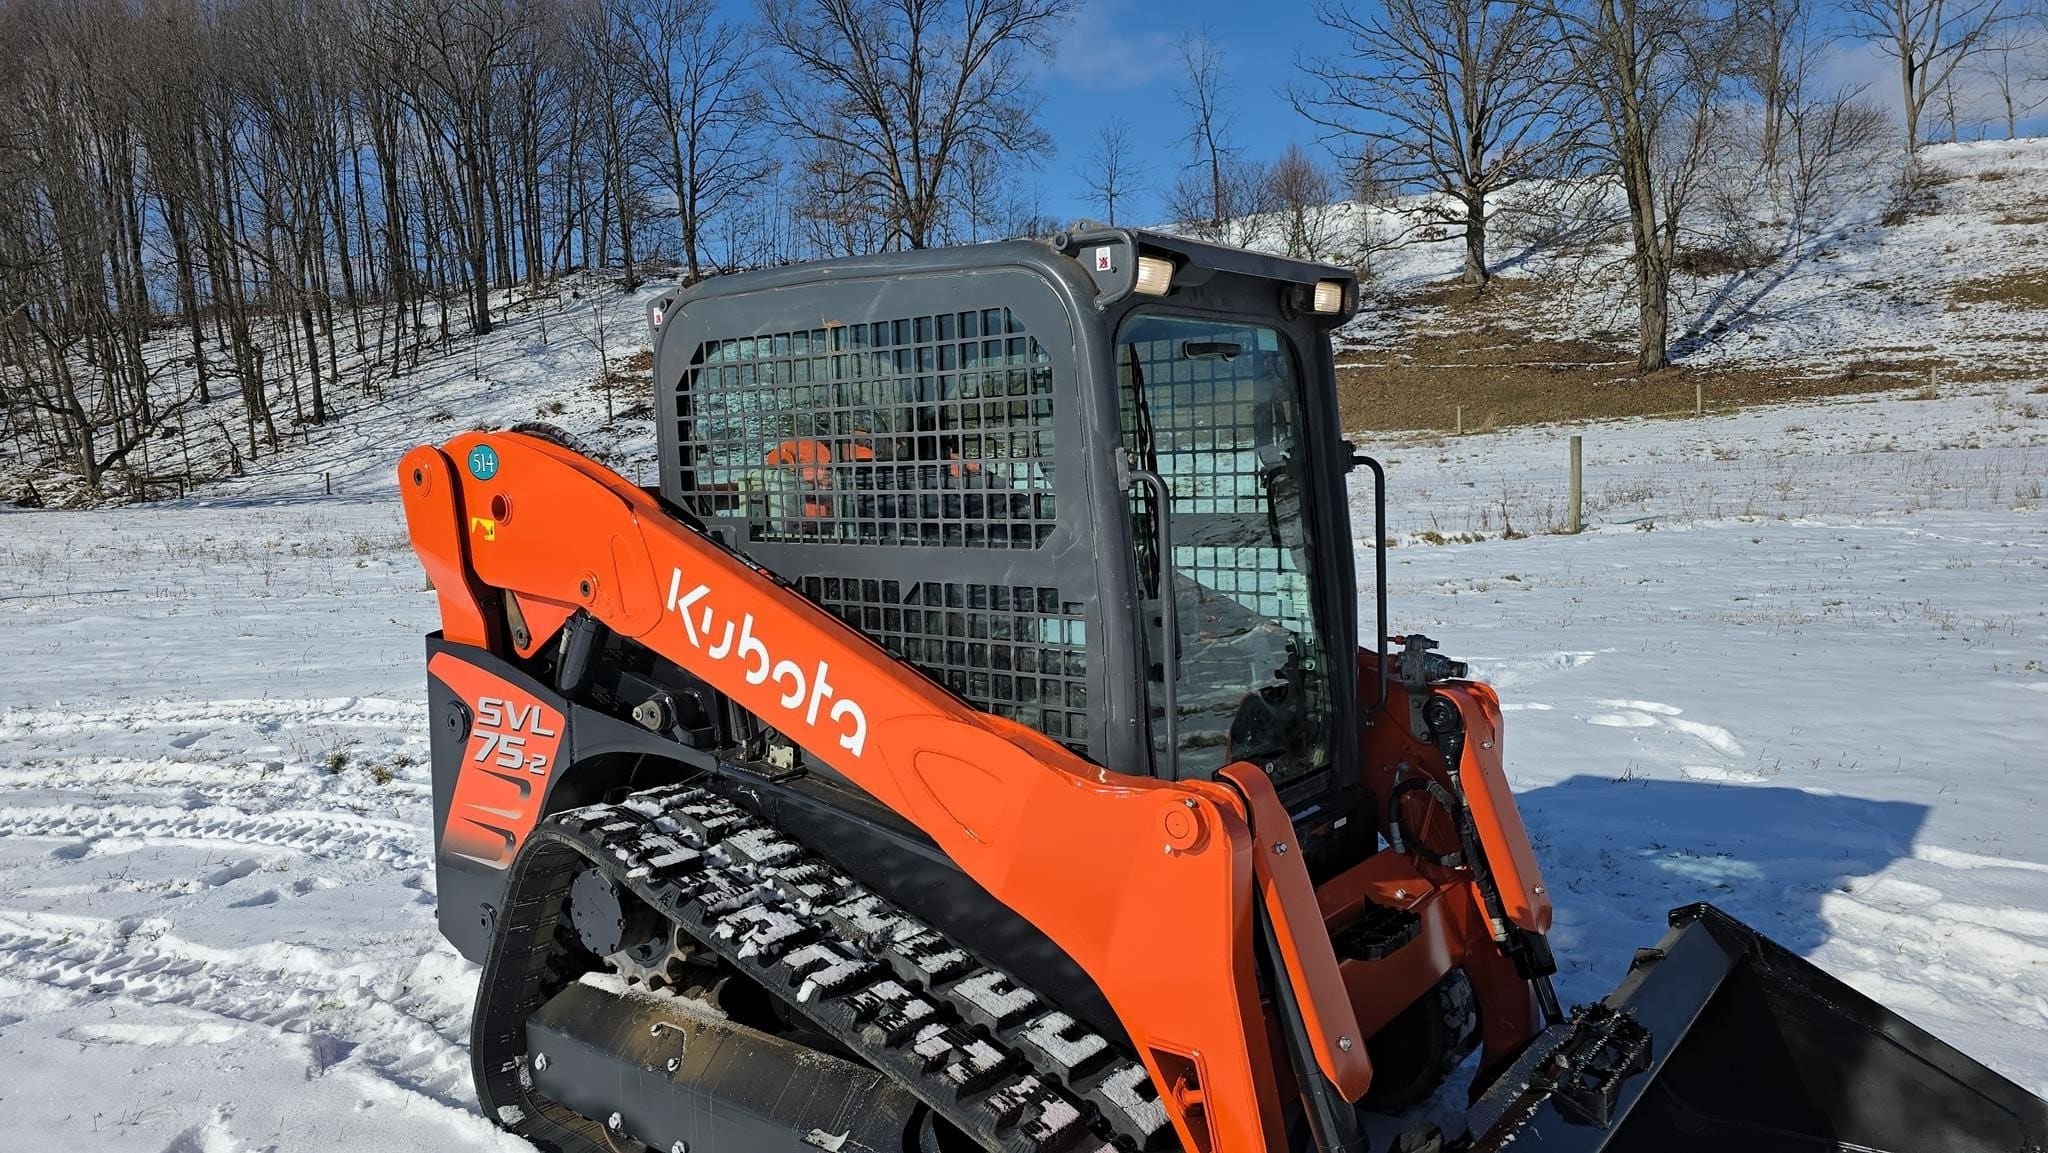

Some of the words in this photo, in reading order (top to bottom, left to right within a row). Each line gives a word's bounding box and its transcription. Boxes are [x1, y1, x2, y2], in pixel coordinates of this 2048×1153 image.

[473, 452, 495, 473] 514
[667, 566, 867, 758] Kubota
[477, 696, 555, 737] SVL
[473, 728, 547, 776] 75-2
